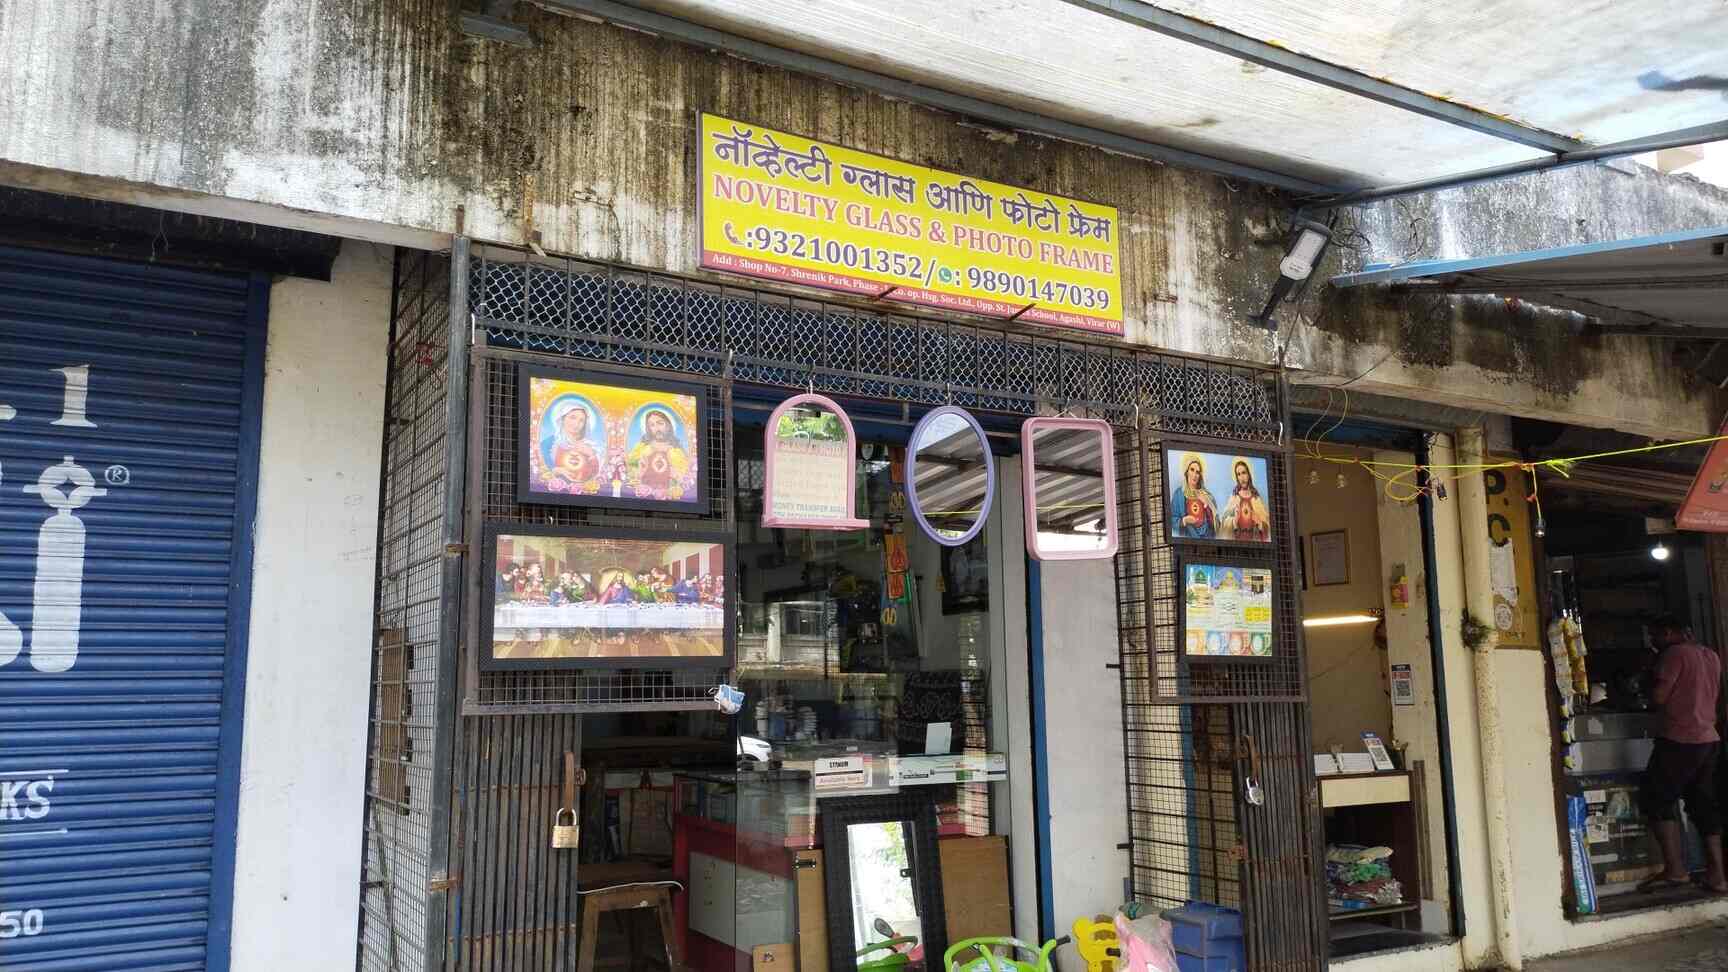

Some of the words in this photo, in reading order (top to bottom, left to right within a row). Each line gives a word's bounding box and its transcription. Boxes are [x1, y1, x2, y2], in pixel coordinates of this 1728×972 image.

[713, 174, 839, 222] NOVELTY
[845, 203, 922, 239] GLASS
[928, 220, 947, 244] &
[953, 224, 1034, 260] PHOTO
[1040, 242, 1114, 274] FRAME
[840, 164, 916, 204] ग्लास
[926, 180, 993, 220] आणि
[1000, 193, 1061, 234] फोटो
[1066, 203, 1112, 243] फ्रेम
[713, 253, 732, 265] Add
[739, 258, 763, 272] Shop
[791, 268, 827, 283] Shrenik
[967, 267, 1110, 310] 9890147039
